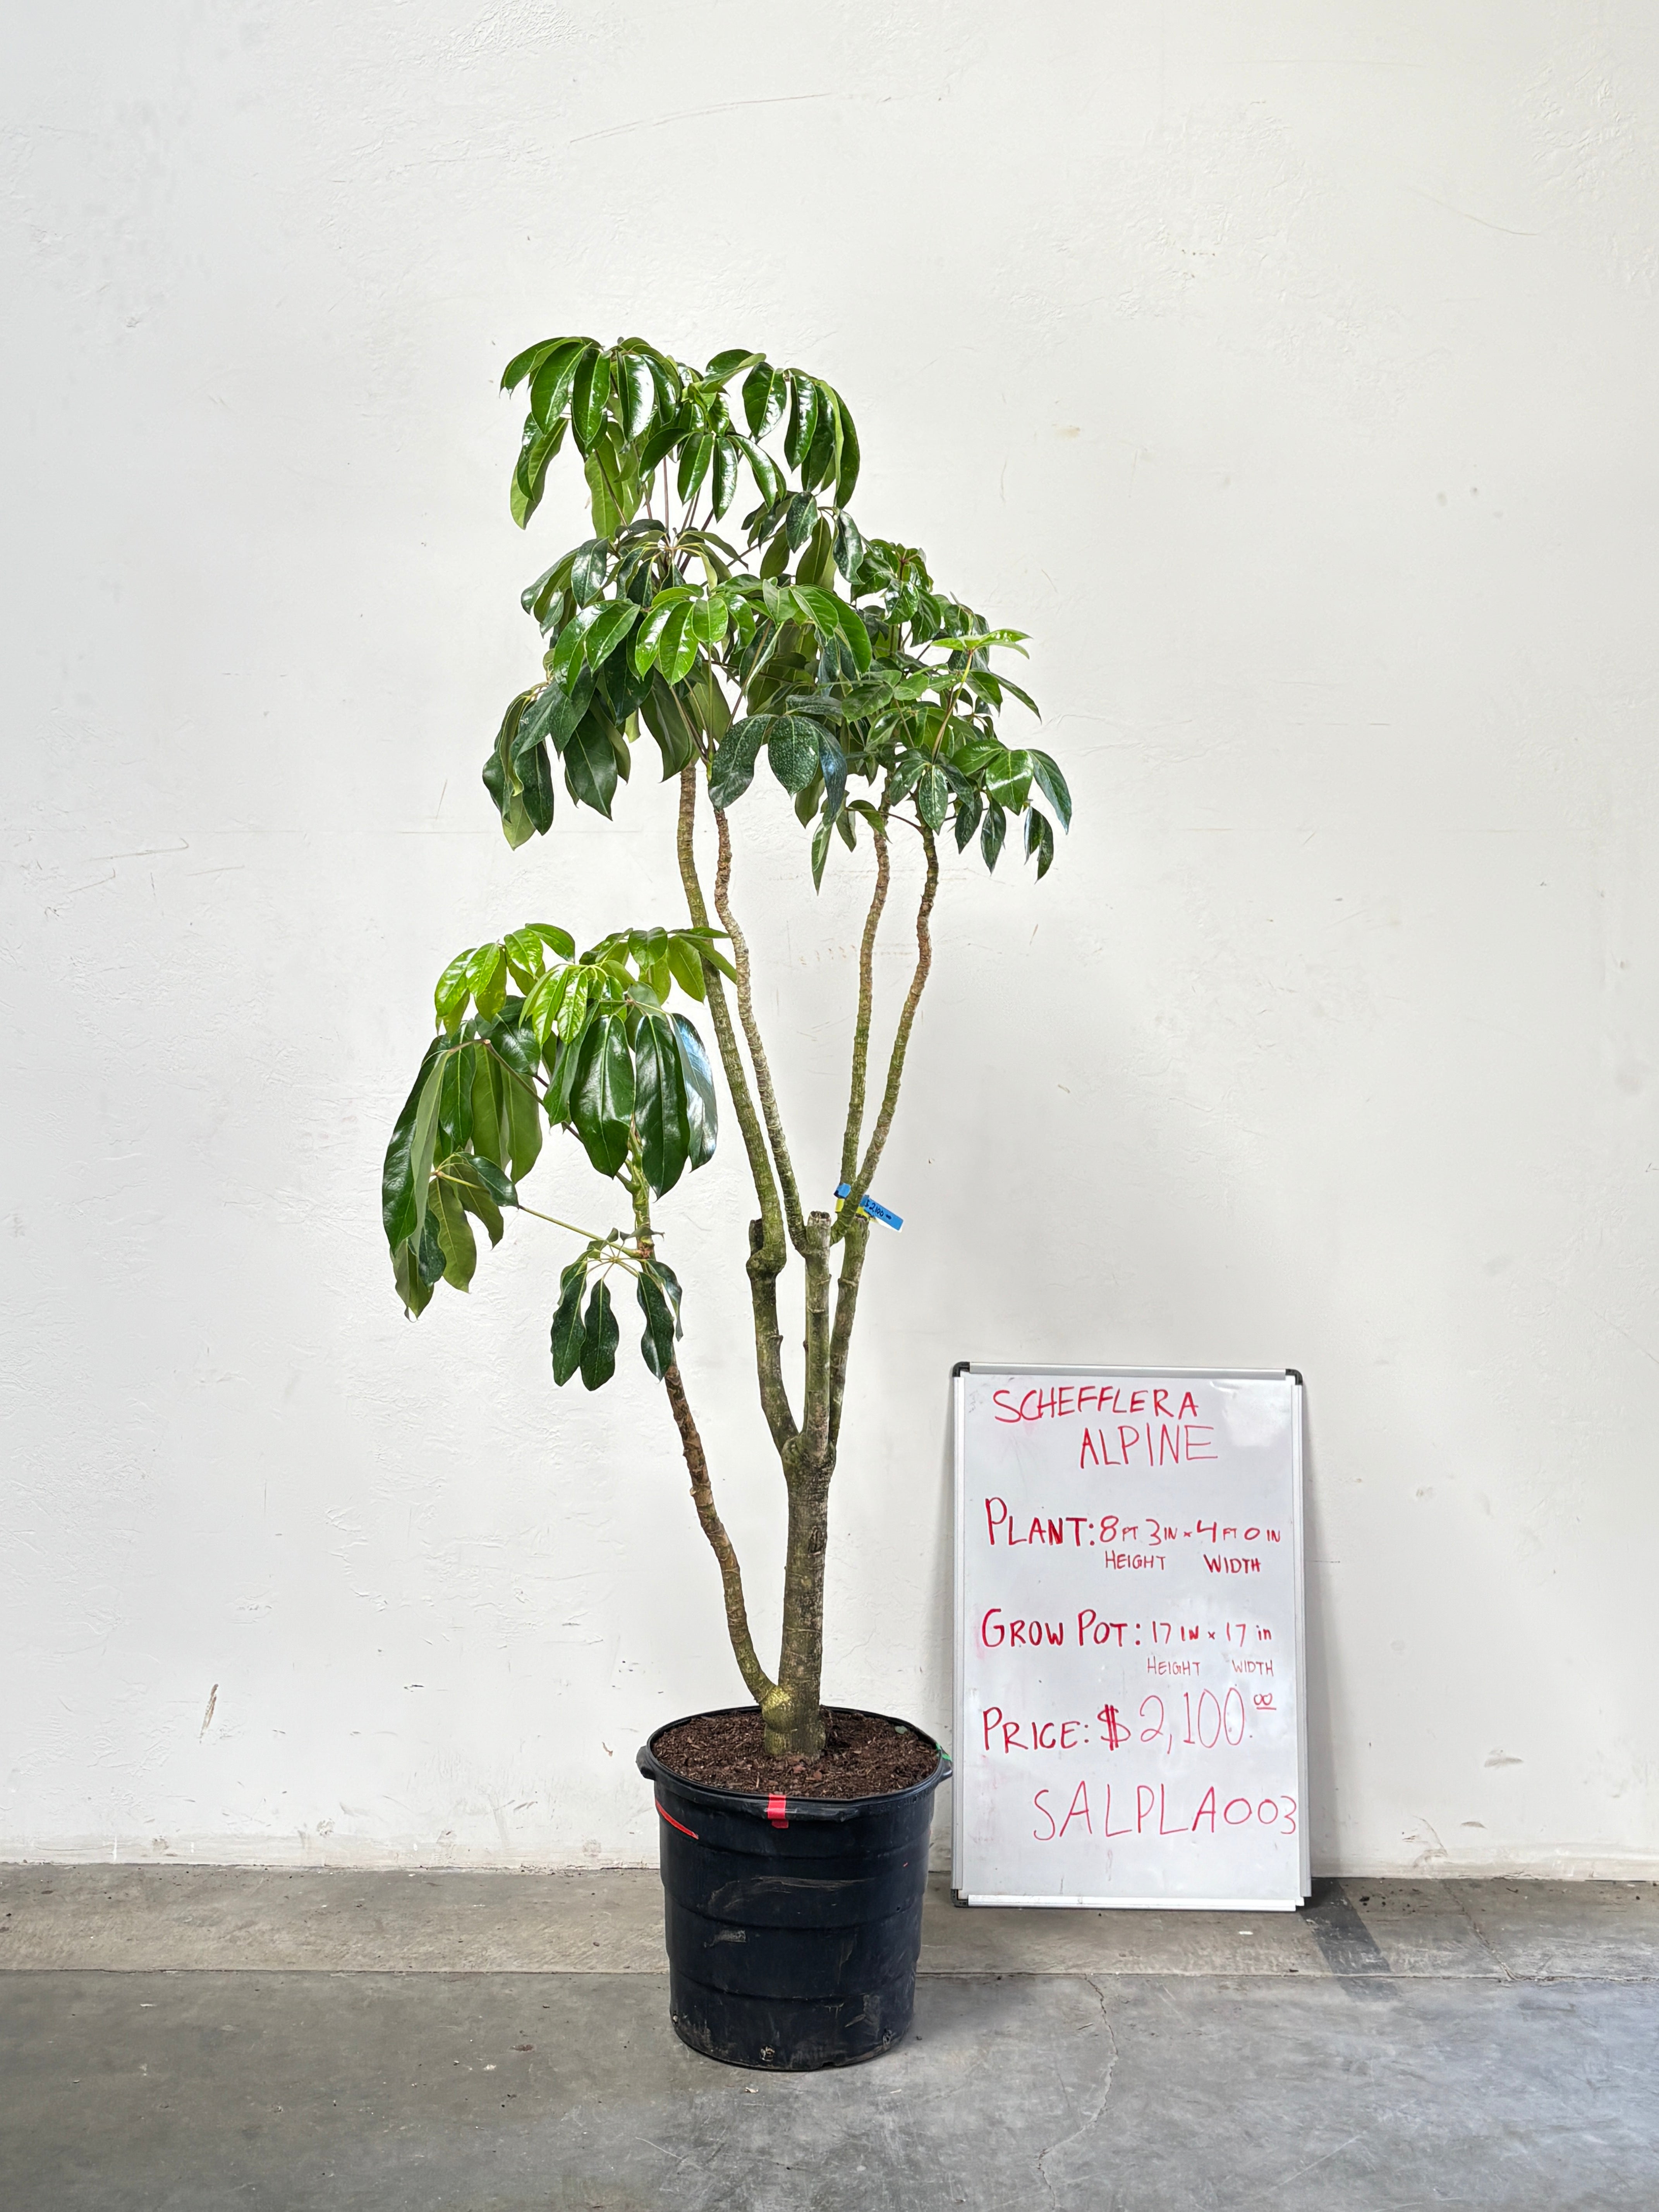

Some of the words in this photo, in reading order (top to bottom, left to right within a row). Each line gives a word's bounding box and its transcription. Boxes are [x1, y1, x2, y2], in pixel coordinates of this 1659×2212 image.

[993, 1386, 1199, 1423] SCHEFFLERA
[1080, 1423, 1218, 1469] ALPINE
[985, 1497, 1094, 1547] PLANT:
[1099, 1515, 1119, 1543] 8
[1146, 1518, 1161, 1546] 3
[1196, 1520, 1217, 1543] 4
[1266, 1530, 1281, 1542] IN
[1105, 1550, 1166, 1570] HEIGHT
[1203, 1554, 1261, 1574] WIDTH
[981, 1608, 1064, 1648] GROW
[1077, 1609, 1141, 1647] POT:
[1152, 1621, 1171, 1644] 17
[1226, 1622, 1246, 1647] 17
[1147, 1656, 1200, 1676] HEIGHT
[1231, 1659, 1274, 1677] WIDTH
[982, 1707, 1089, 1754] PRICE:
